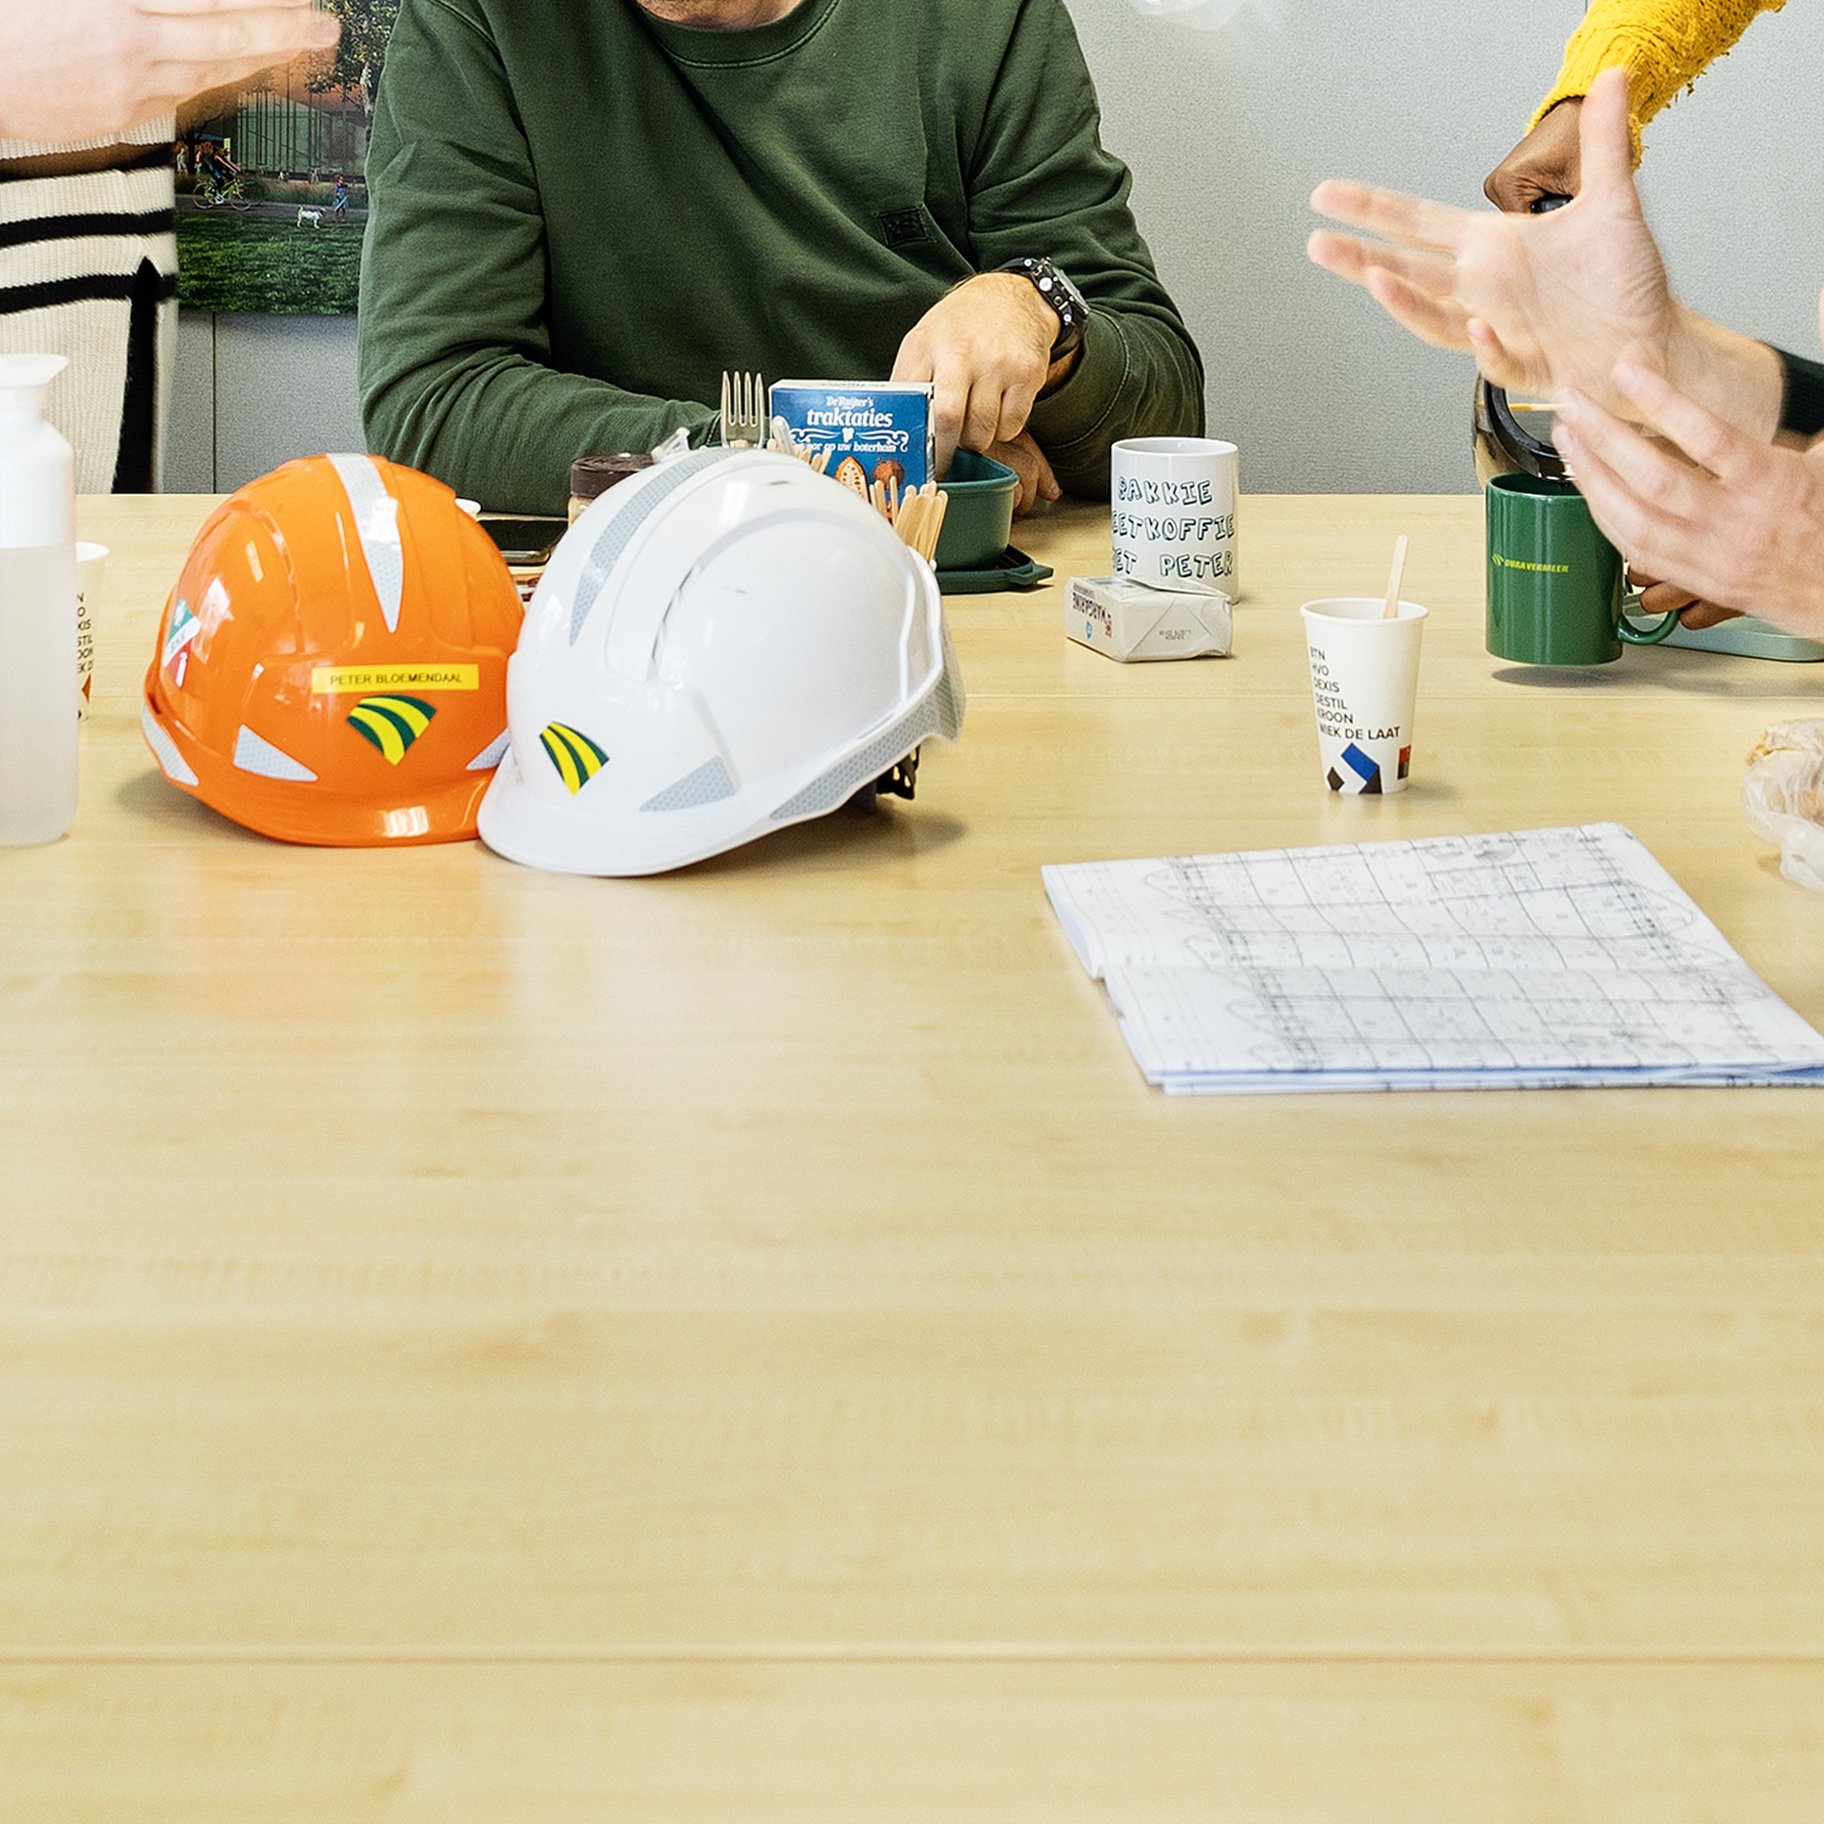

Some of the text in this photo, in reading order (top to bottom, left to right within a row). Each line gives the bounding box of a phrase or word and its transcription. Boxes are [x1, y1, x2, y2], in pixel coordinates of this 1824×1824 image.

[807, 409, 893, 427] traktaties
[853, 442, 897, 453] boterham
[1160, 551, 1234, 578] PETER
[330, 673, 461, 685] PETER BLOEMENDAAL
[1345, 728, 1364, 740] DE
[1368, 726, 1401, 739] LAAT
